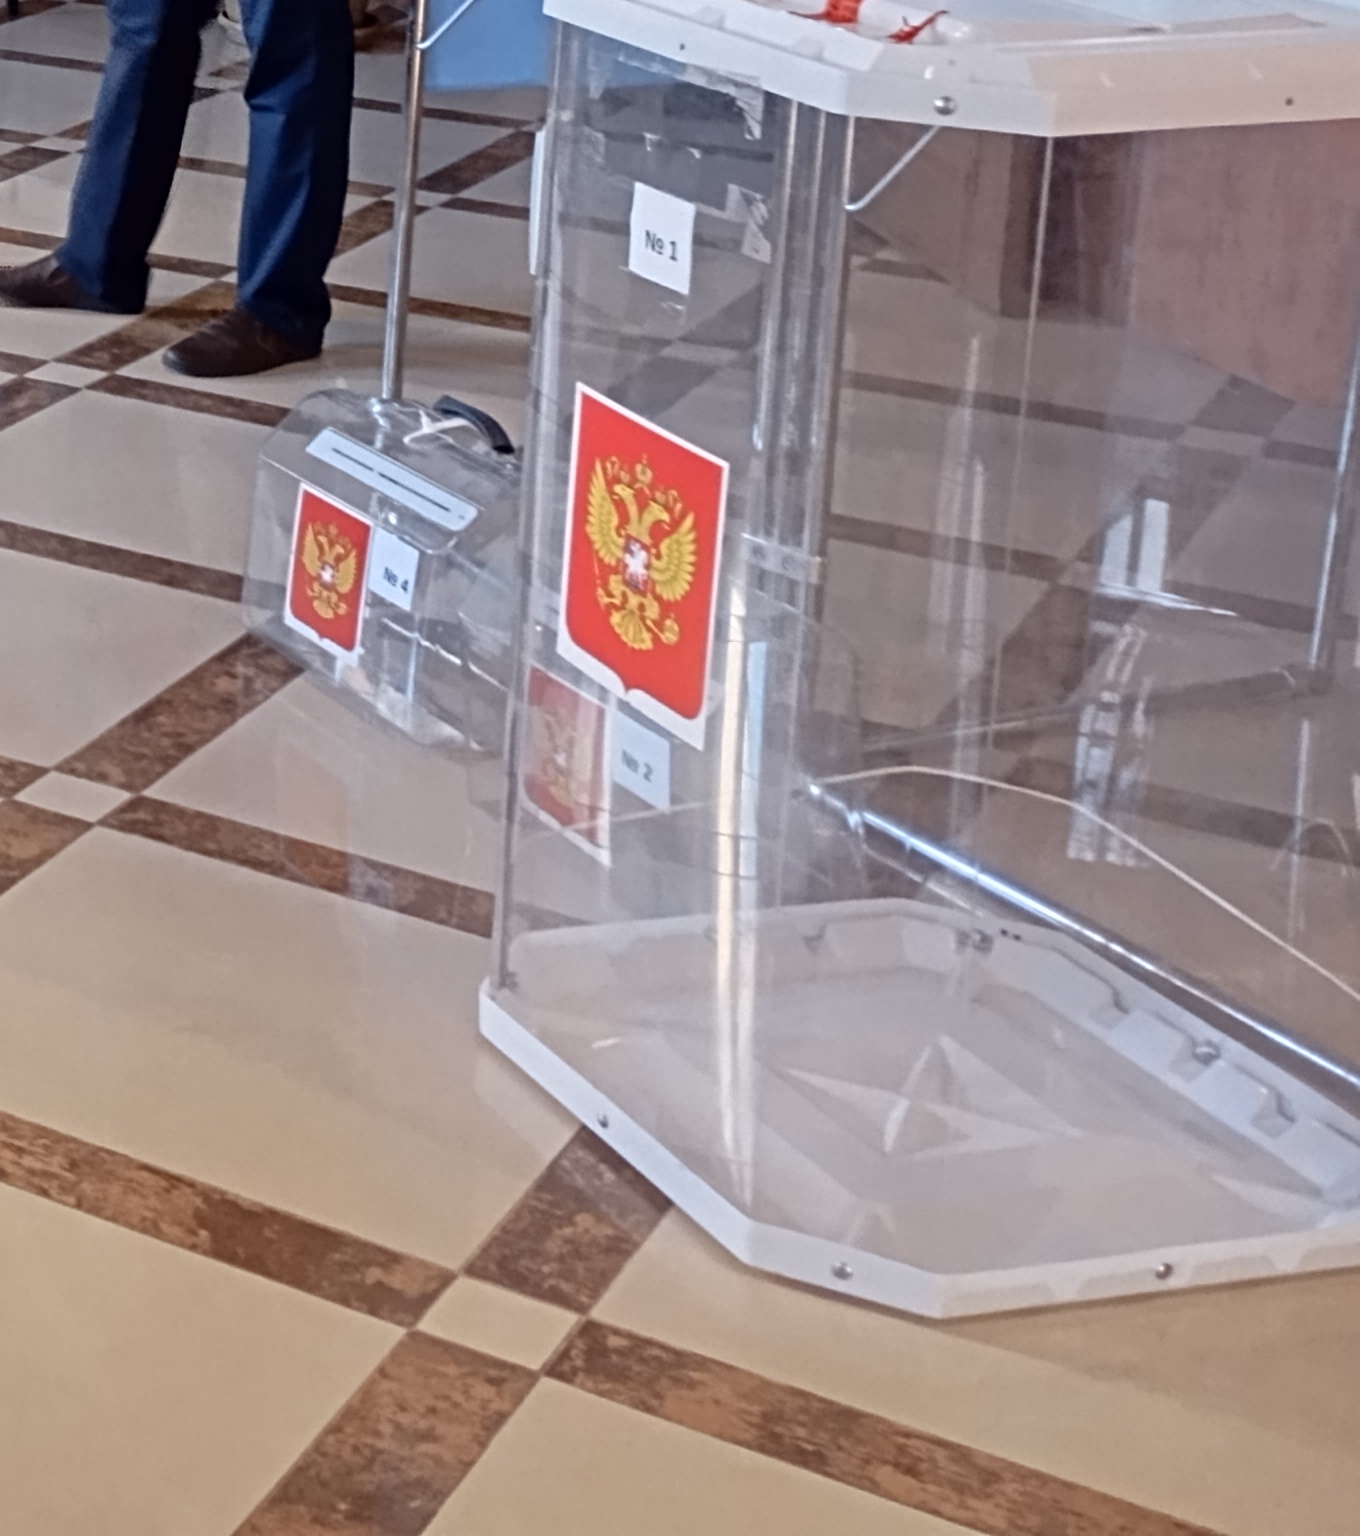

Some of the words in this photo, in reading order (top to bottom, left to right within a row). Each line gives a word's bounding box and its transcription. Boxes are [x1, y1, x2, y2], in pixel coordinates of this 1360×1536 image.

[644, 228, 664, 256] №
[668, 239, 679, 263] 1
[383, 565, 399, 588] №
[400, 578, 409, 595] 4
[642, 762, 654, 784] 2
